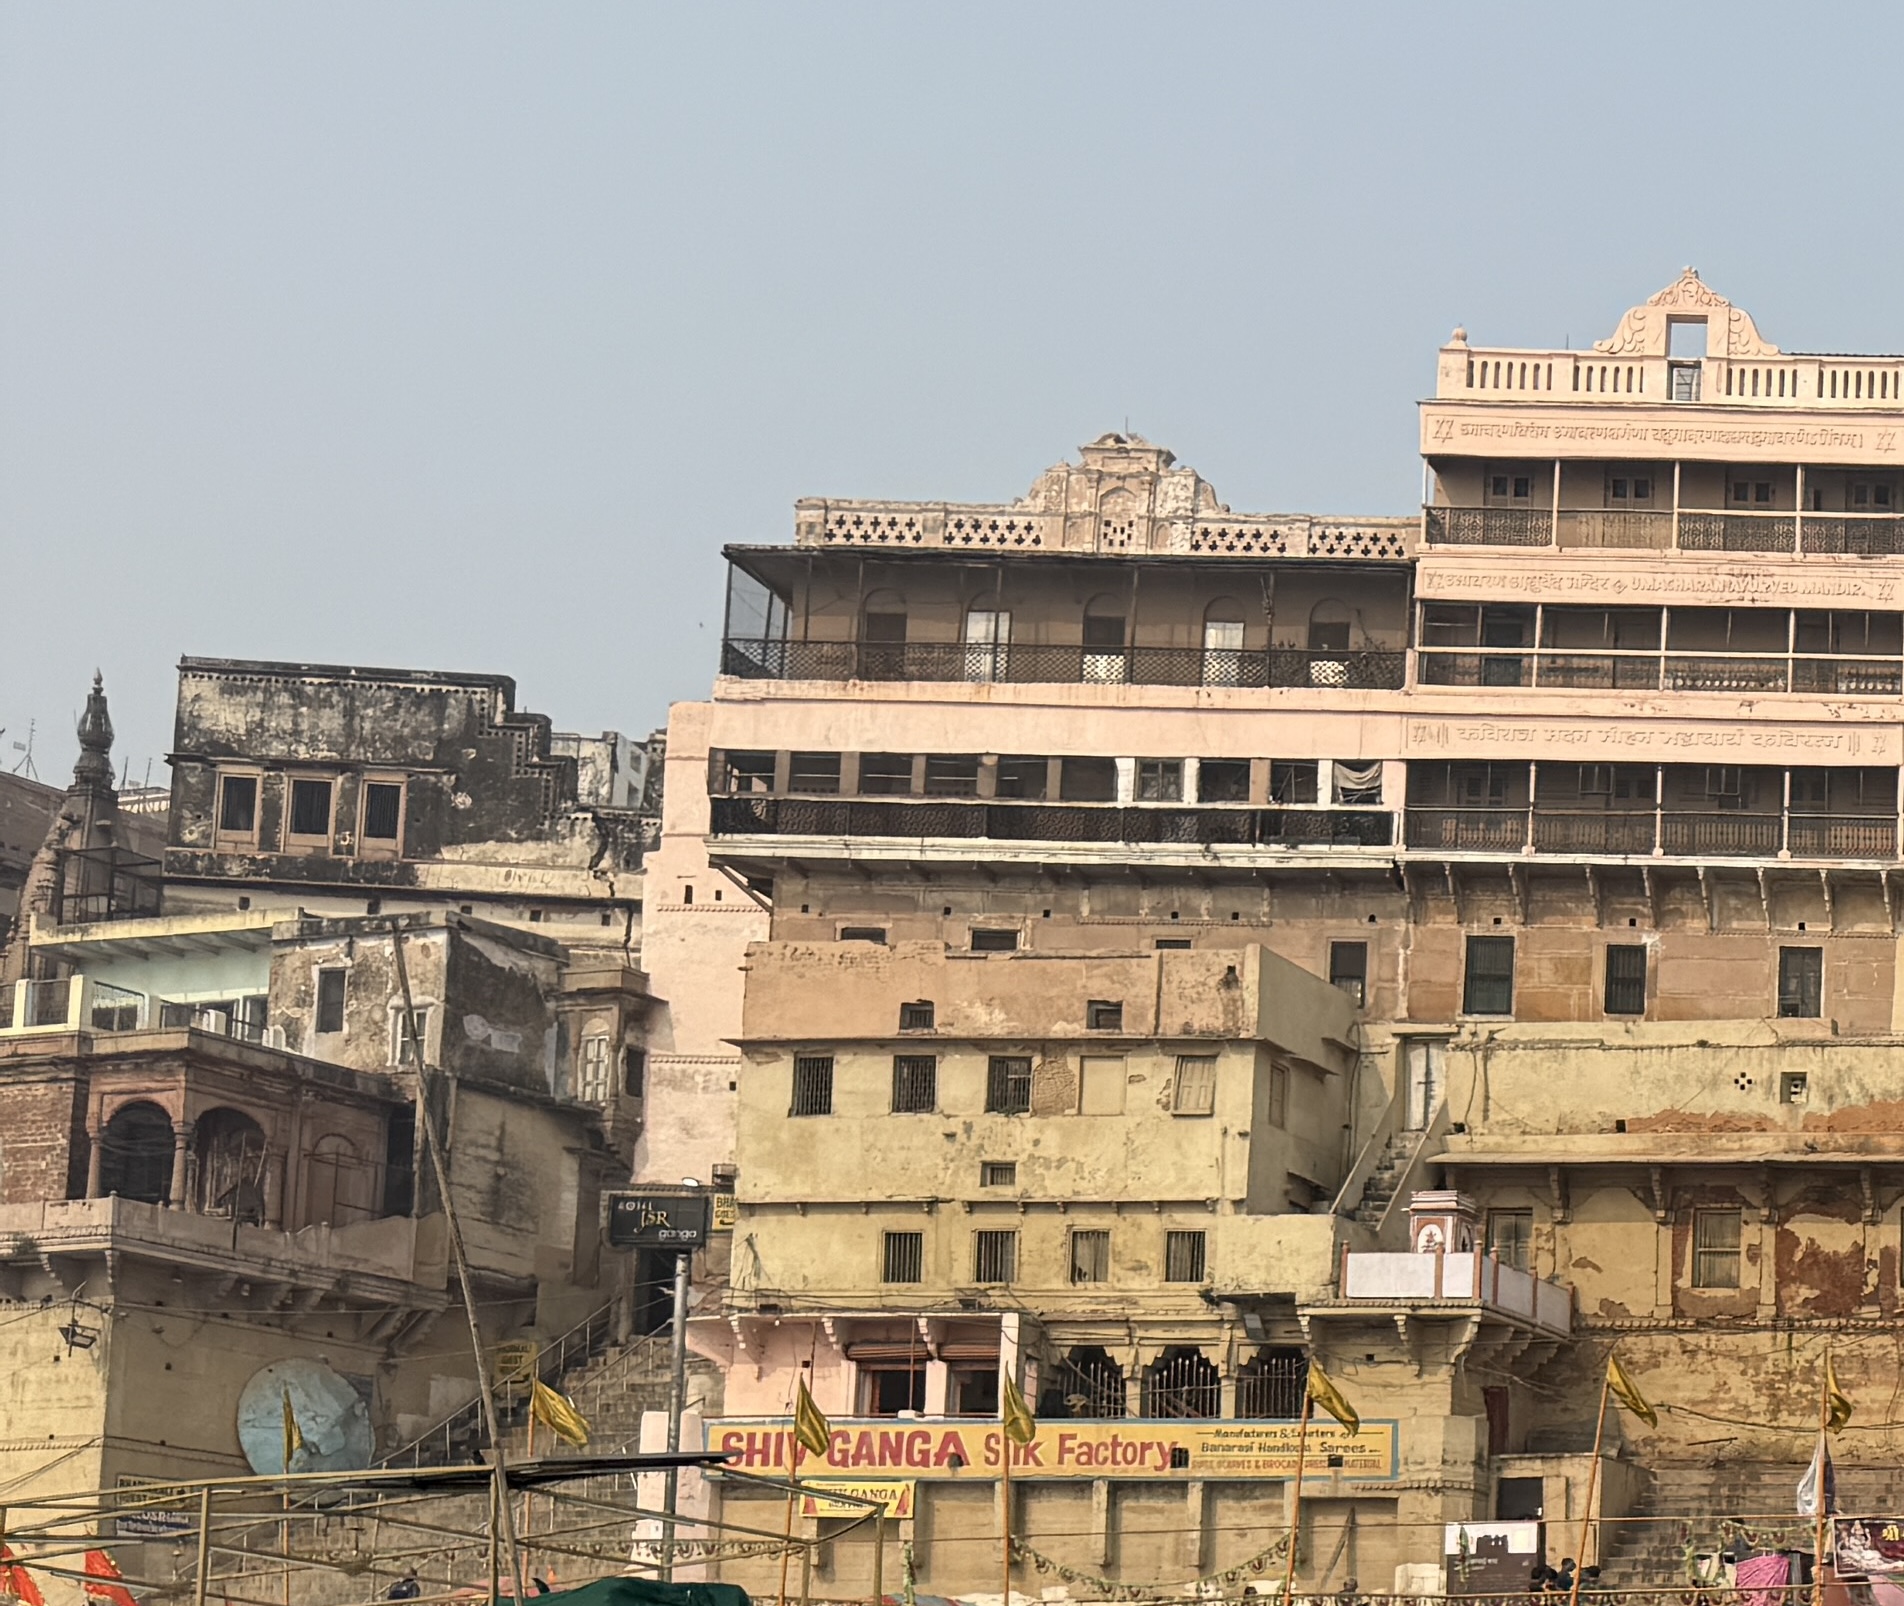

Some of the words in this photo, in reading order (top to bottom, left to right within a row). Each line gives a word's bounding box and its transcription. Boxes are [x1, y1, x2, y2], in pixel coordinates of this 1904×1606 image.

[827, 1430, 971, 1469] GANGA
[984, 1432, 1044, 1467] Slk
[1057, 1433, 1179, 1472] Factory
